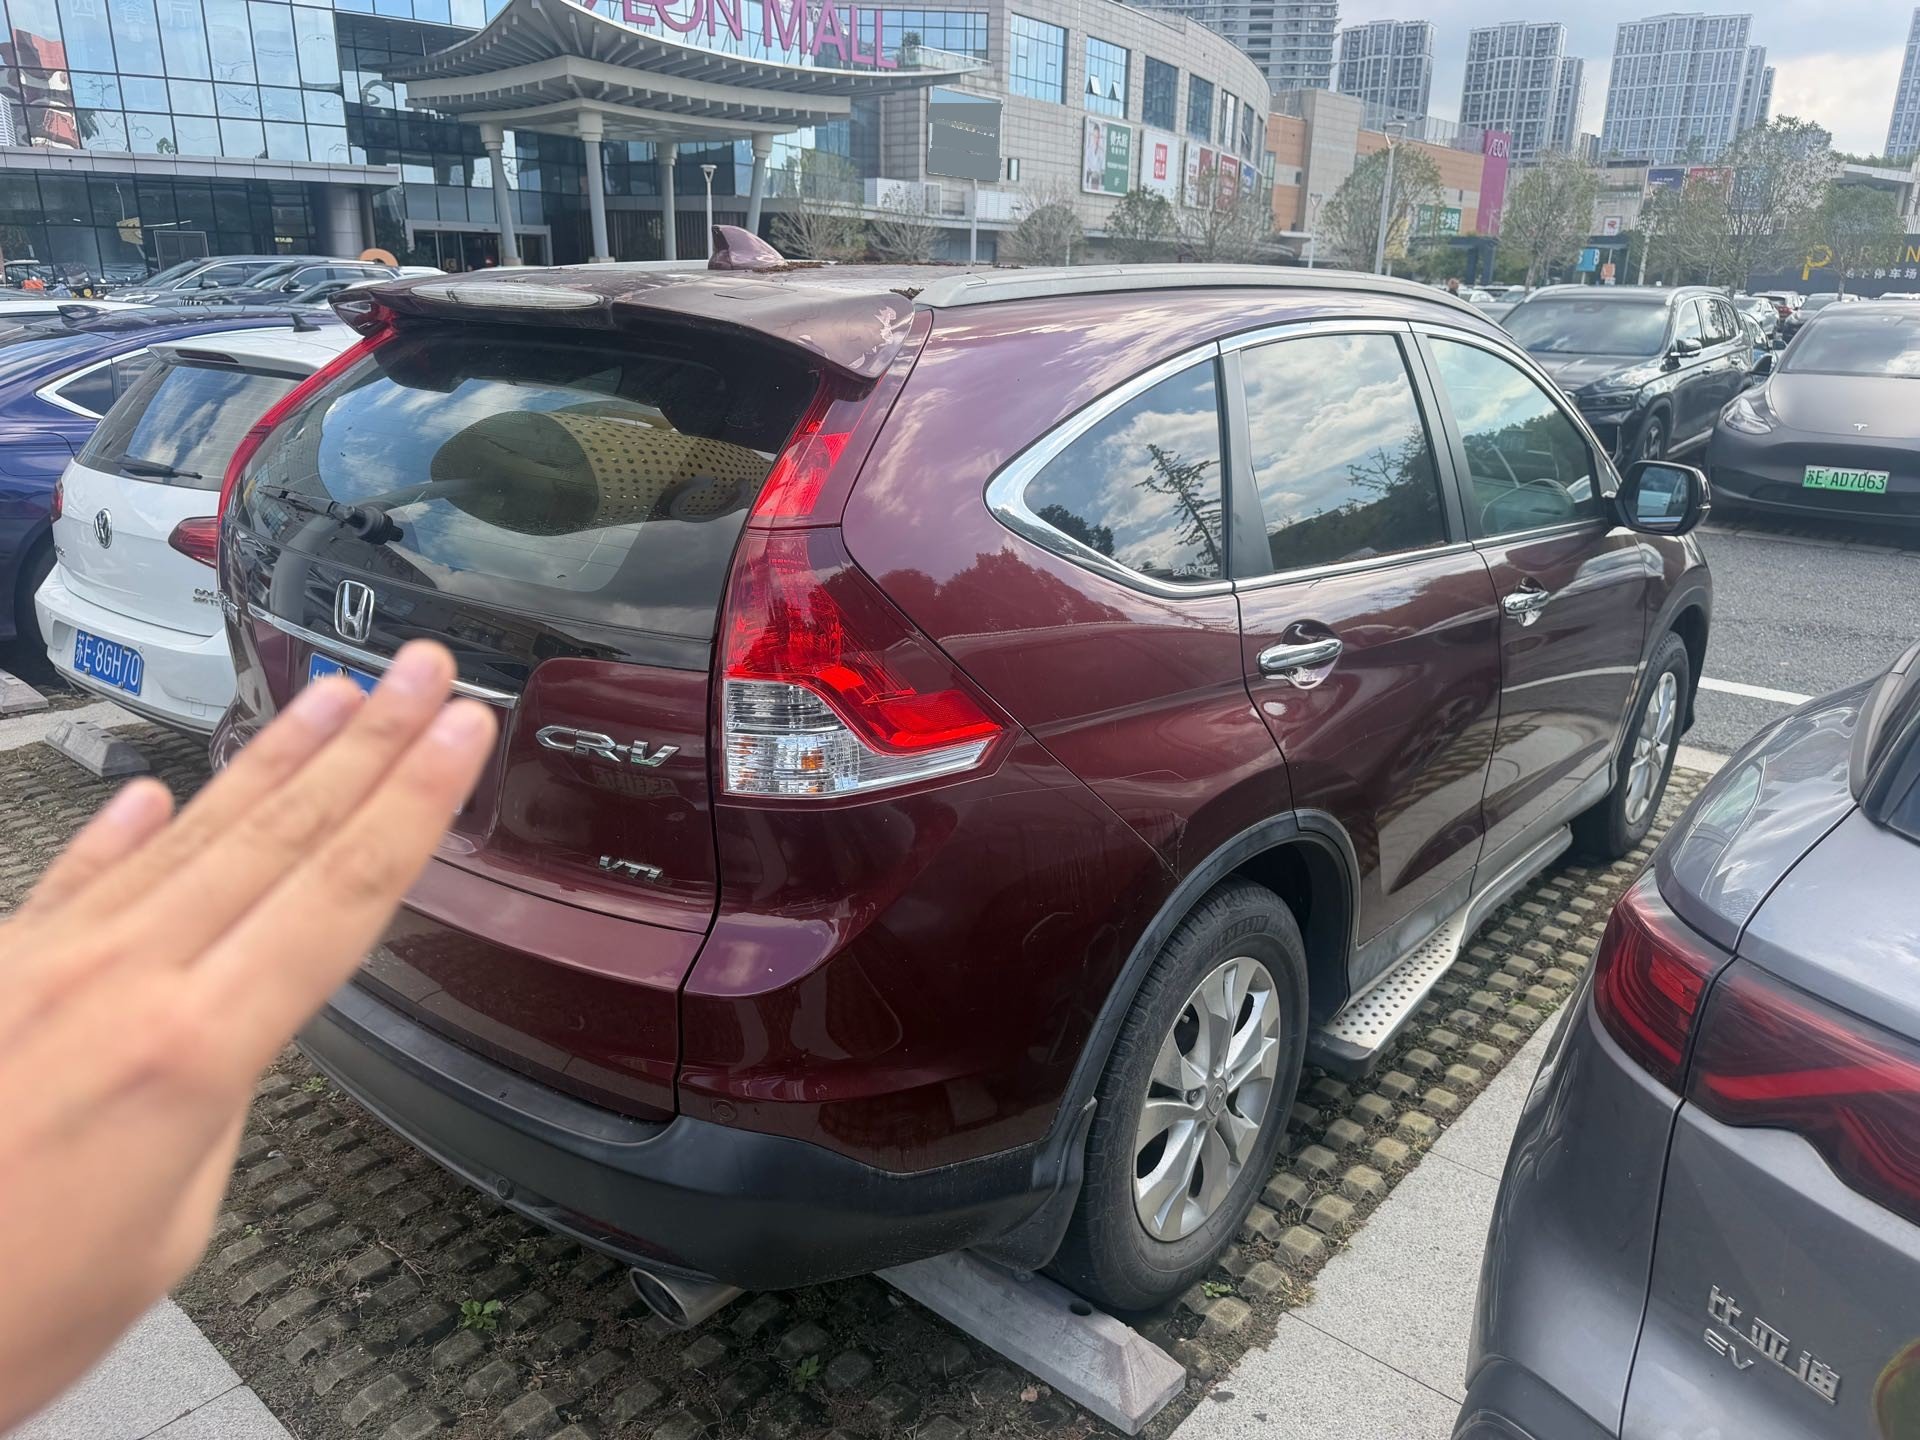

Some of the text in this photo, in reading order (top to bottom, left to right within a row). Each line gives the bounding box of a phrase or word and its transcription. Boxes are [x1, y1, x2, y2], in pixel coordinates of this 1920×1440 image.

[762, 0, 897, 68] MALL
[535, 725, 680, 767] CR-V
[1703, 1328, 1755, 1370] EV
[1707, 1284, 1841, 1406] 比亚迪
